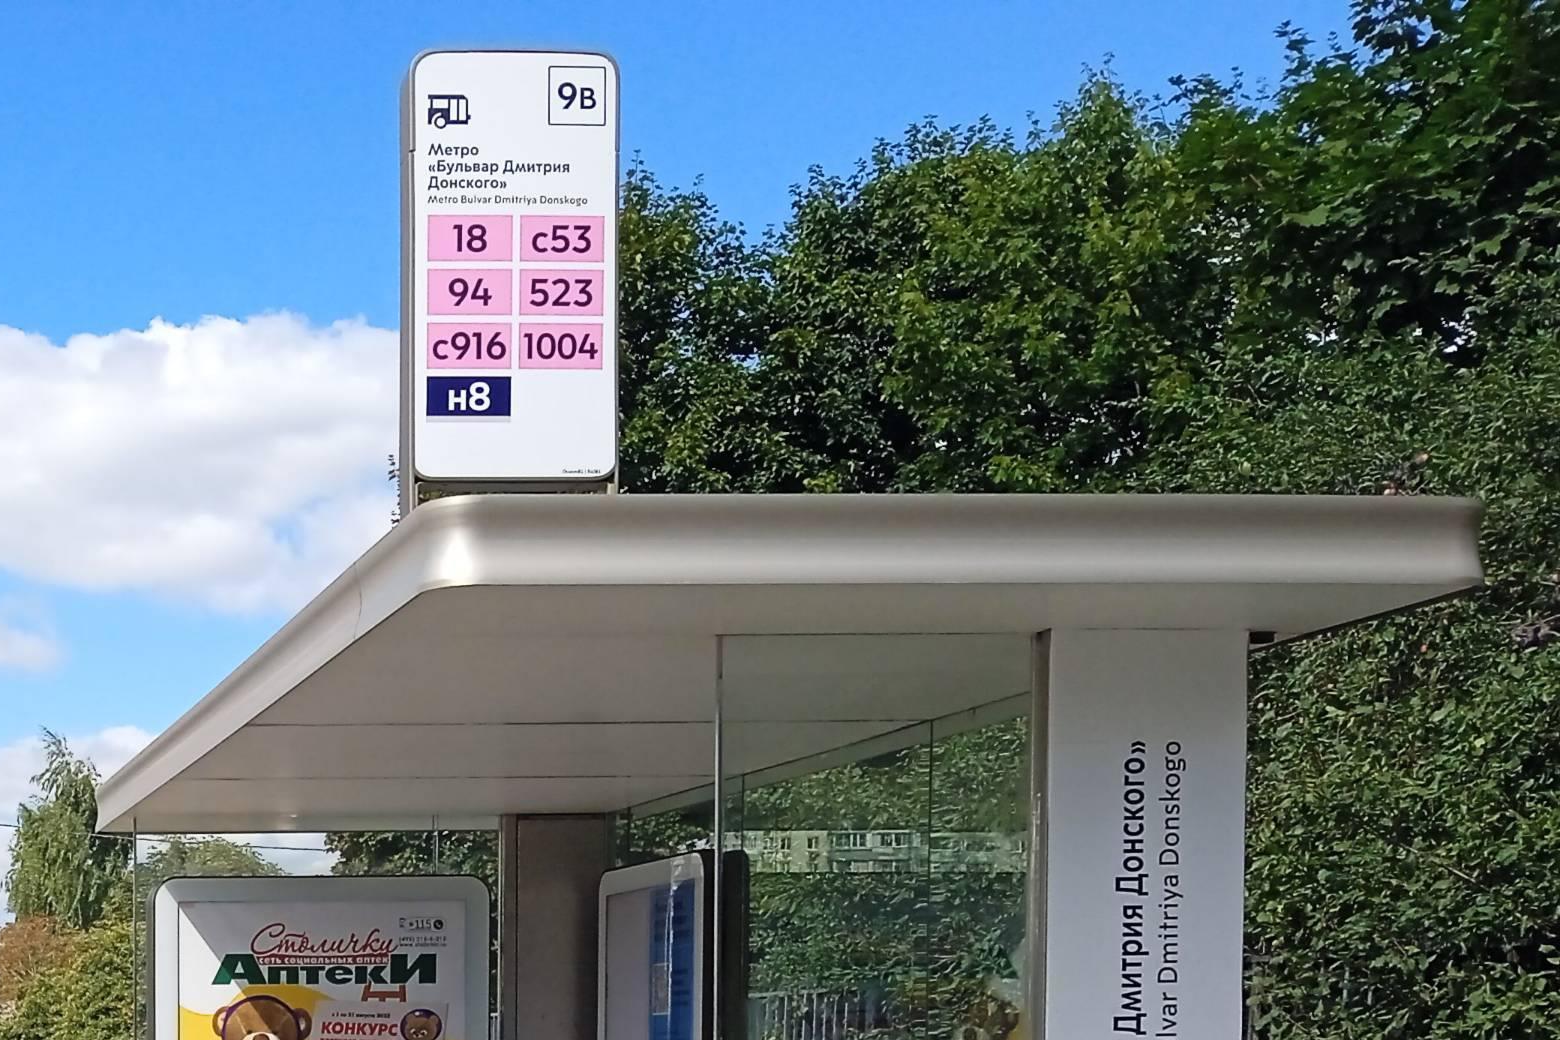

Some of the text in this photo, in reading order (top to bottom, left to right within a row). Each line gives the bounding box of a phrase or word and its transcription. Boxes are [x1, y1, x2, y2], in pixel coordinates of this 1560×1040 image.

[427, 143, 479, 158] Метро
[428, 160, 570, 175] «Бульвар Дмитрия
[427, 176, 507, 190] Донского»
[427, 195, 588, 206] Metro Bulvar Dmitriya Donskogo
[453, 224, 488, 253] 18
[531, 224, 591, 254] с53
[448, 278, 492, 307] 94
[529, 278, 593, 307] 523
[432, 331, 507, 361] с916
[523, 332, 598, 360] 1004
[448, 382, 491, 411] н8
[1158, 740, 1186, 865] Donskogo
[1115, 740, 1149, 896] Донского»
[250, 922, 399, 956] Столички
[1157, 874, 1184, 984] Dmitriya
[258, 956, 389, 965] сеть социальных аптек
[1113, 904, 1149, 1035] Дмитрия
[321, 1021, 398, 1036] КОНКУРС
